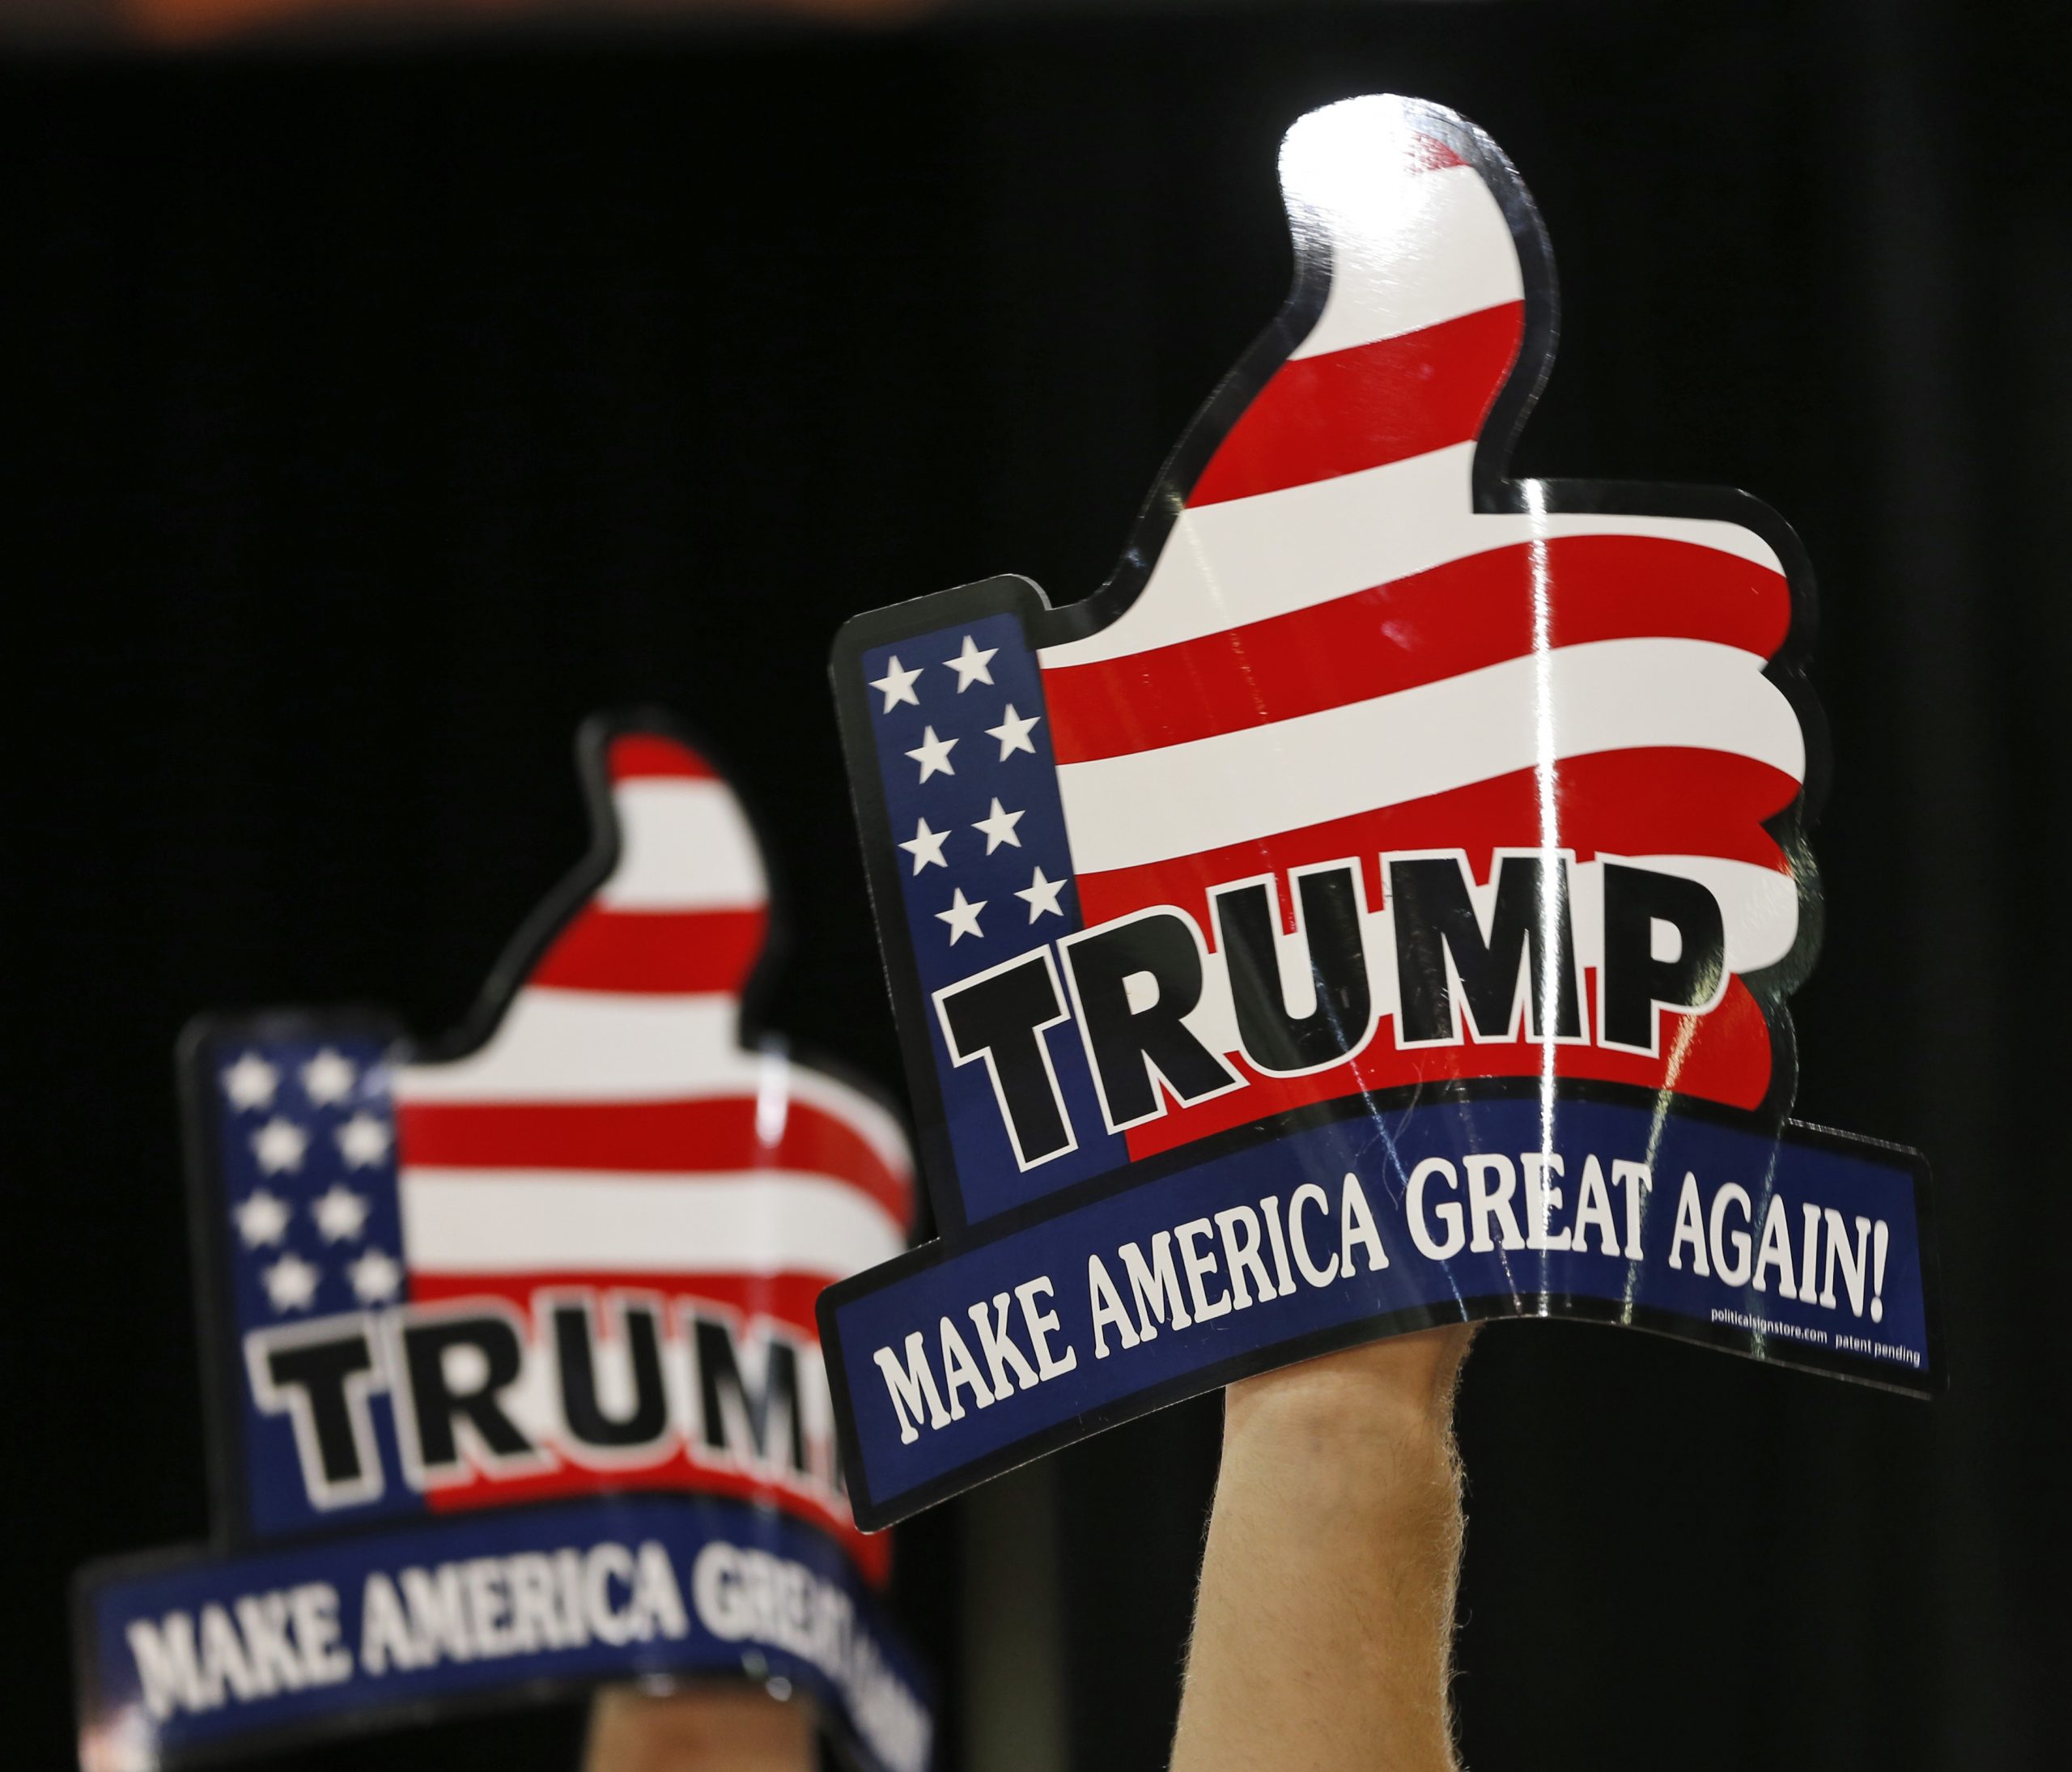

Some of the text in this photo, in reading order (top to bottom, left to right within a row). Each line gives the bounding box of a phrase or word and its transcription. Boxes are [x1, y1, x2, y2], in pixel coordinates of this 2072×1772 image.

[932, 848, 1731, 1173] TRUMP
[244, 1285, 851, 1511] TRUM
[873, 1153, 1889, 1444] MAKE AMERICA GREAT AGAIN!
[1711, 1308, 1921, 1368] politicalsignstore.com patent pending
[125, 1582, 354, 1721] MAKE
[361, 1542, 690, 1675] AMERICA
